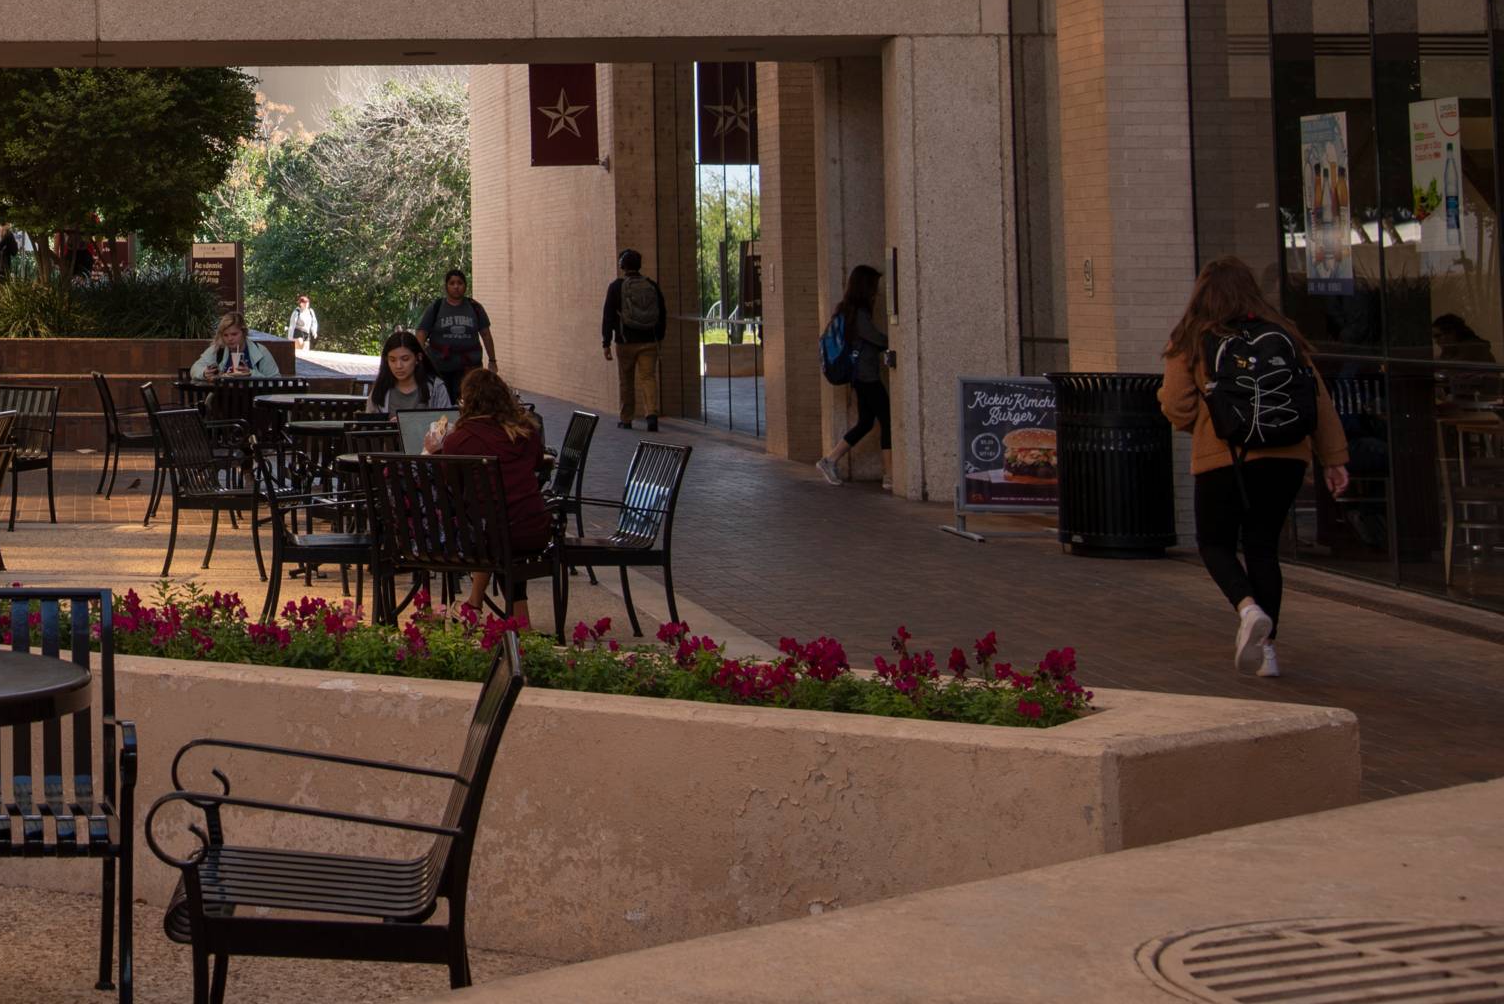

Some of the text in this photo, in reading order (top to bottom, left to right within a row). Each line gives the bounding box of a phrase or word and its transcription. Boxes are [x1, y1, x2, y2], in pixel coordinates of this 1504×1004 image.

[193, 268, 221, 276] rvices
[194, 276, 219, 285] ilding
[440, 316, 453, 328] LAS
[967, 391, 1056, 411] Kickin' Kimchi
